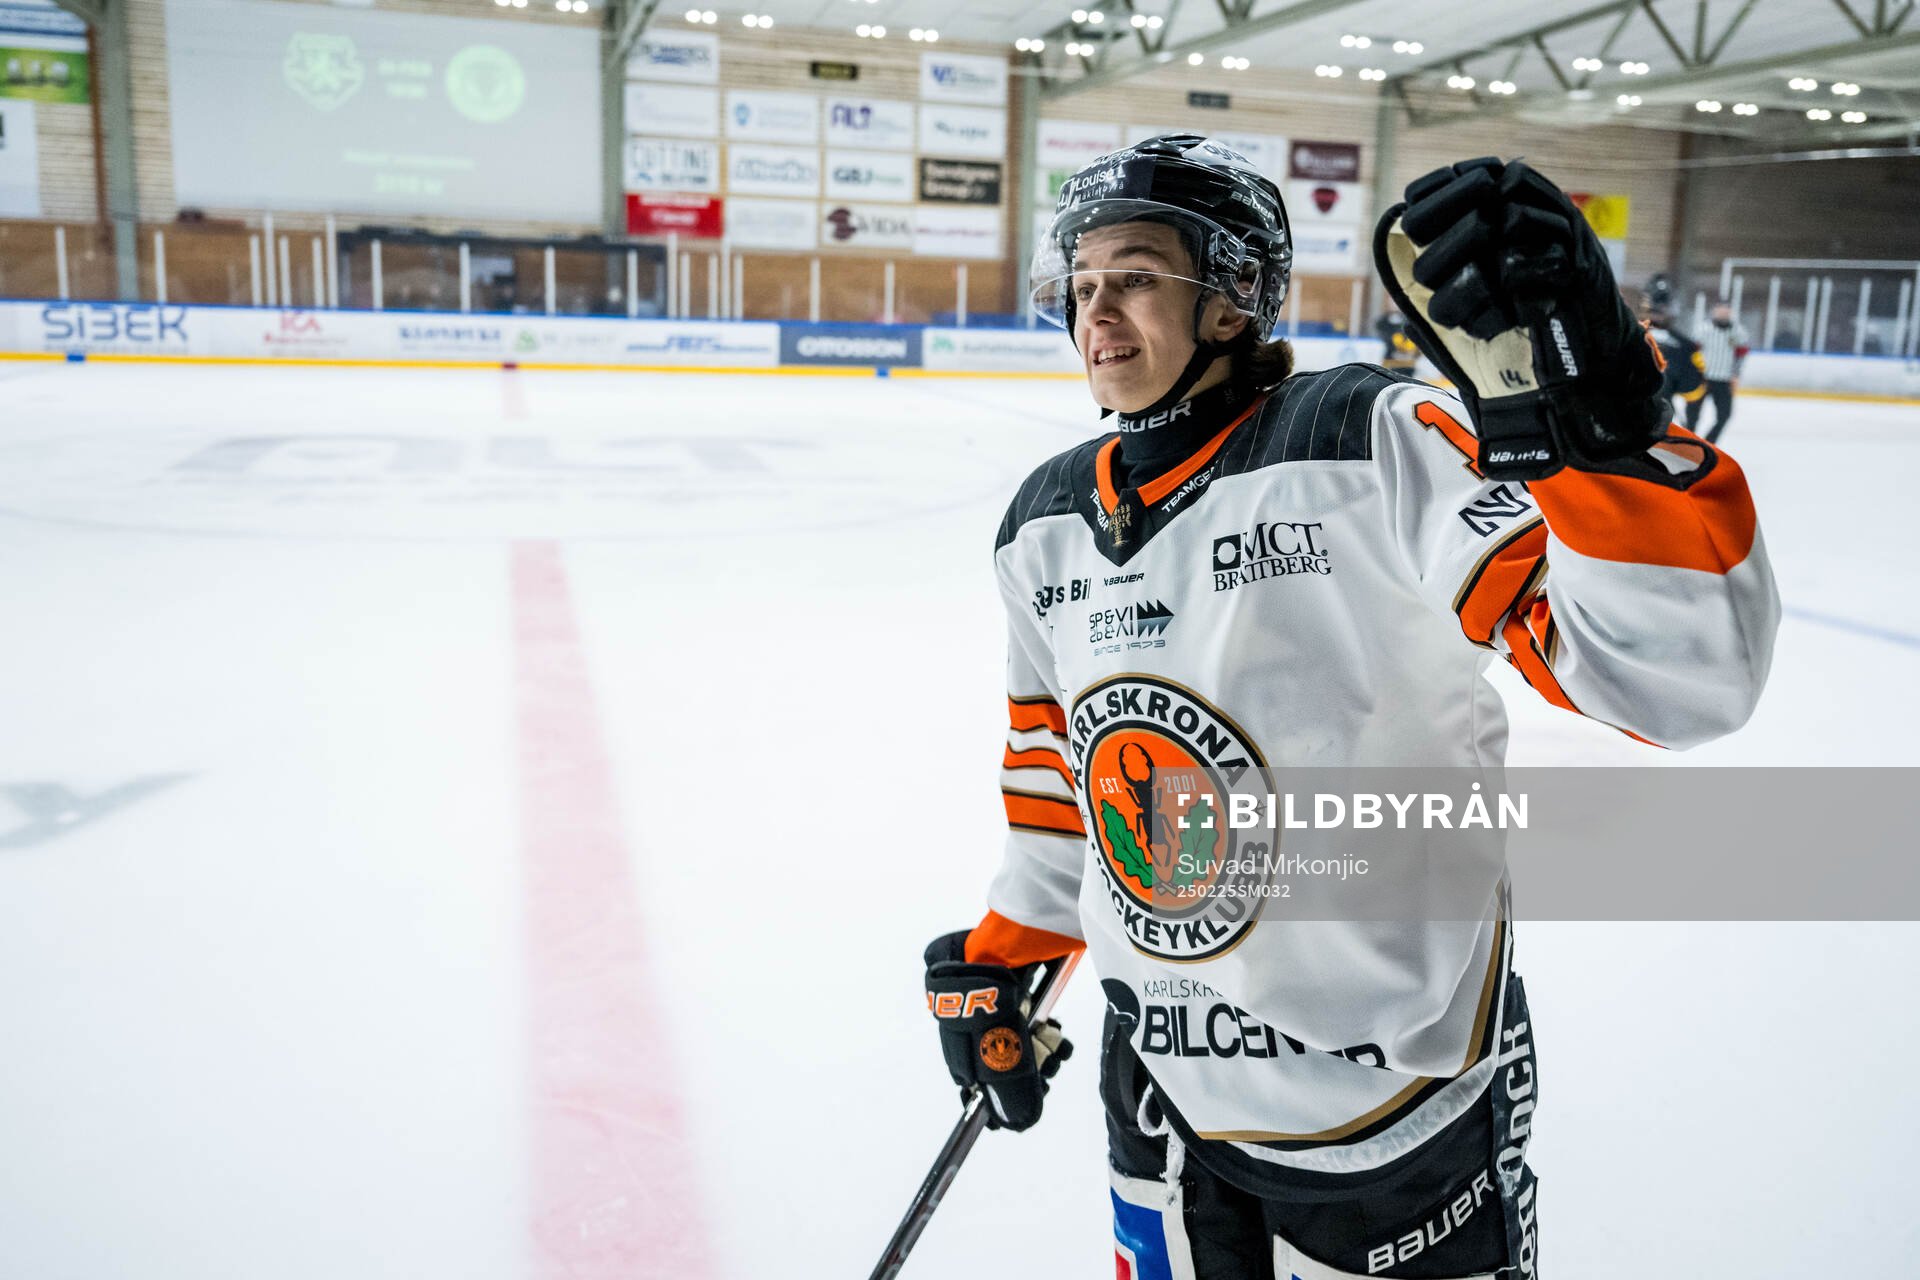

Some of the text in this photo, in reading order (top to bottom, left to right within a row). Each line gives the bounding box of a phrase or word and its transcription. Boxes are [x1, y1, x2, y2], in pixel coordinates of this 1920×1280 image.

[1075, 167, 1117, 192] Louise
[1550, 317, 1579, 377] BAUER
[1161, 464, 1217, 513] TEAMGE
[1107, 572, 1145, 586] BAUER
[1213, 556, 1332, 593] BRATTBERG
[1126, 639, 1167, 651] 1973
[1071, 688, 1250, 791] KARLSKRONA
[1099, 774, 1197, 795] EST. 2001
[1091, 840, 1269, 951] CKEYKLUBB
[1143, 979, 1224, 999] KARLSKR
[1368, 1169, 1496, 1274] BAUER
